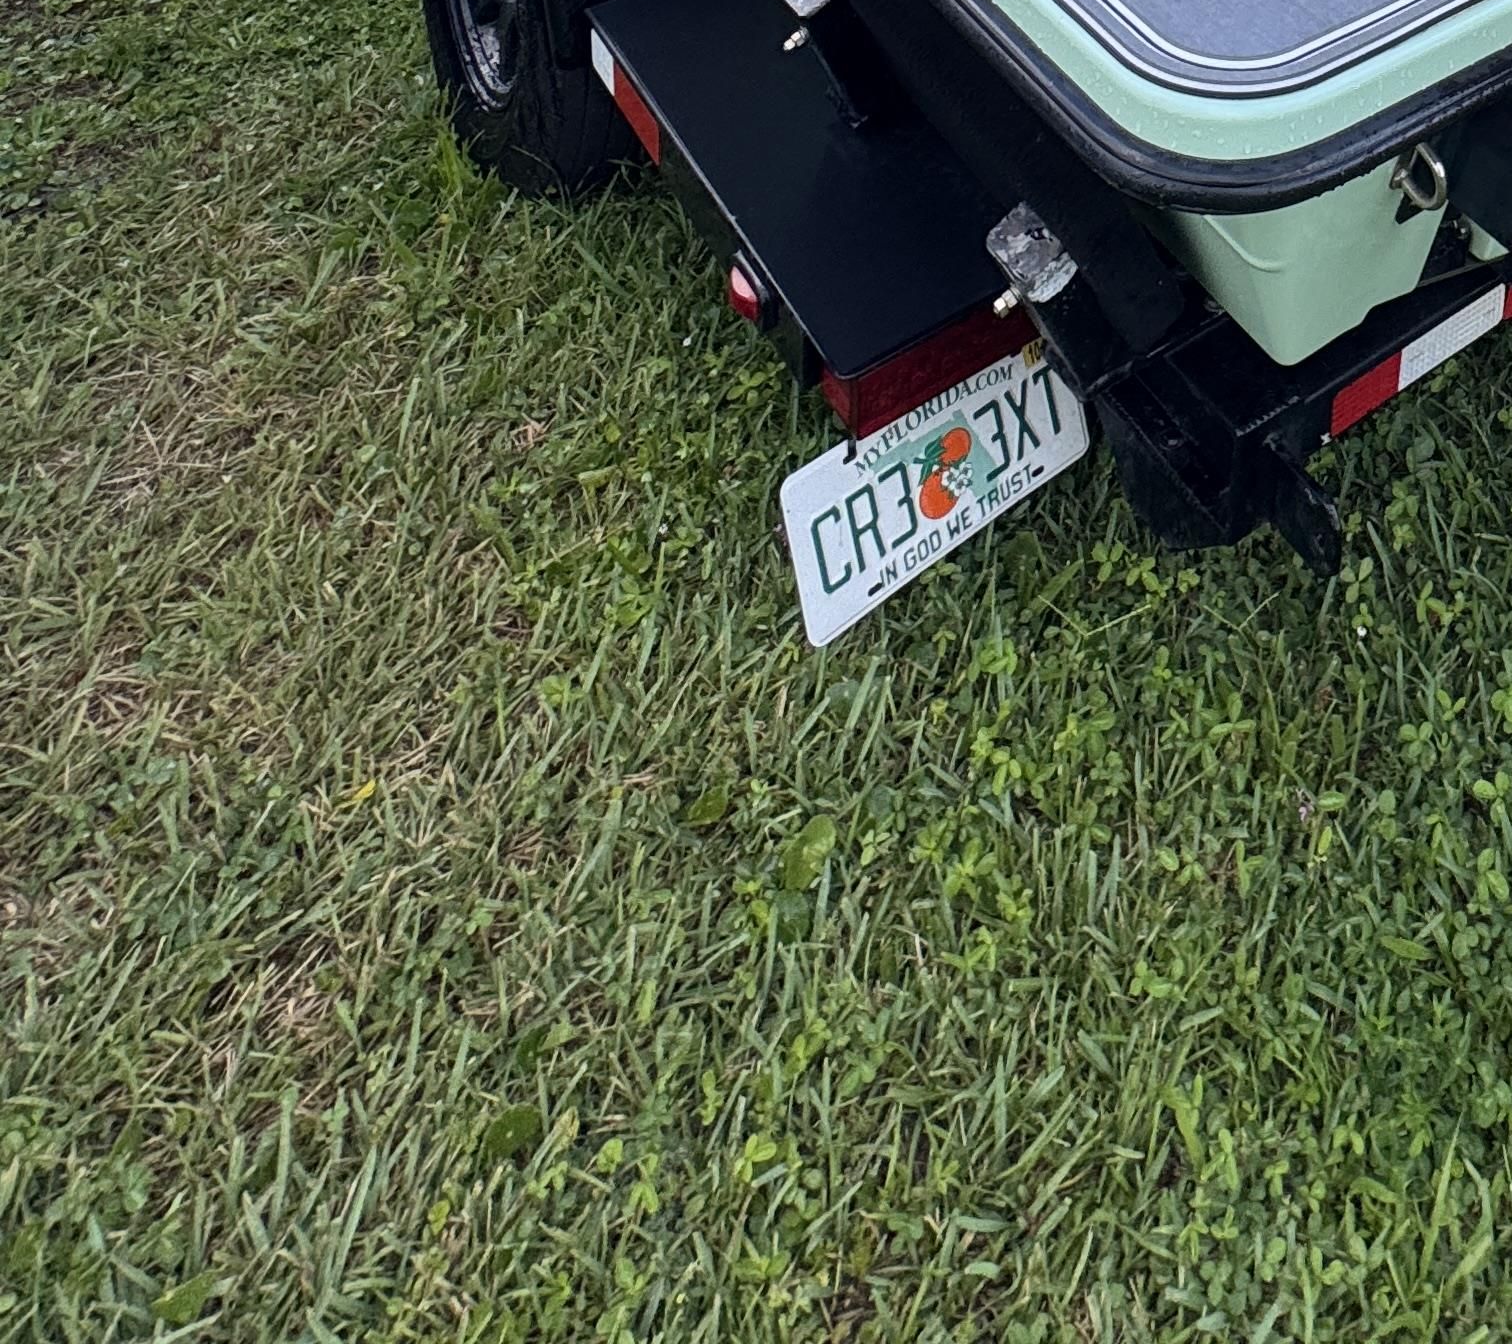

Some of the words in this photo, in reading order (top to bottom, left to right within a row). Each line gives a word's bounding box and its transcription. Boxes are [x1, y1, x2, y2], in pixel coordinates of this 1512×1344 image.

[810, 461, 918, 594] CR3
[973, 365, 1061, 483] 3XT
[853, 363, 1014, 479] MYFLORIDA.COM
[879, 560, 899, 589] IN
[903, 529, 942, 572] GOD
[946, 506, 974, 540] WE
[975, 464, 1033, 518] TRUST
